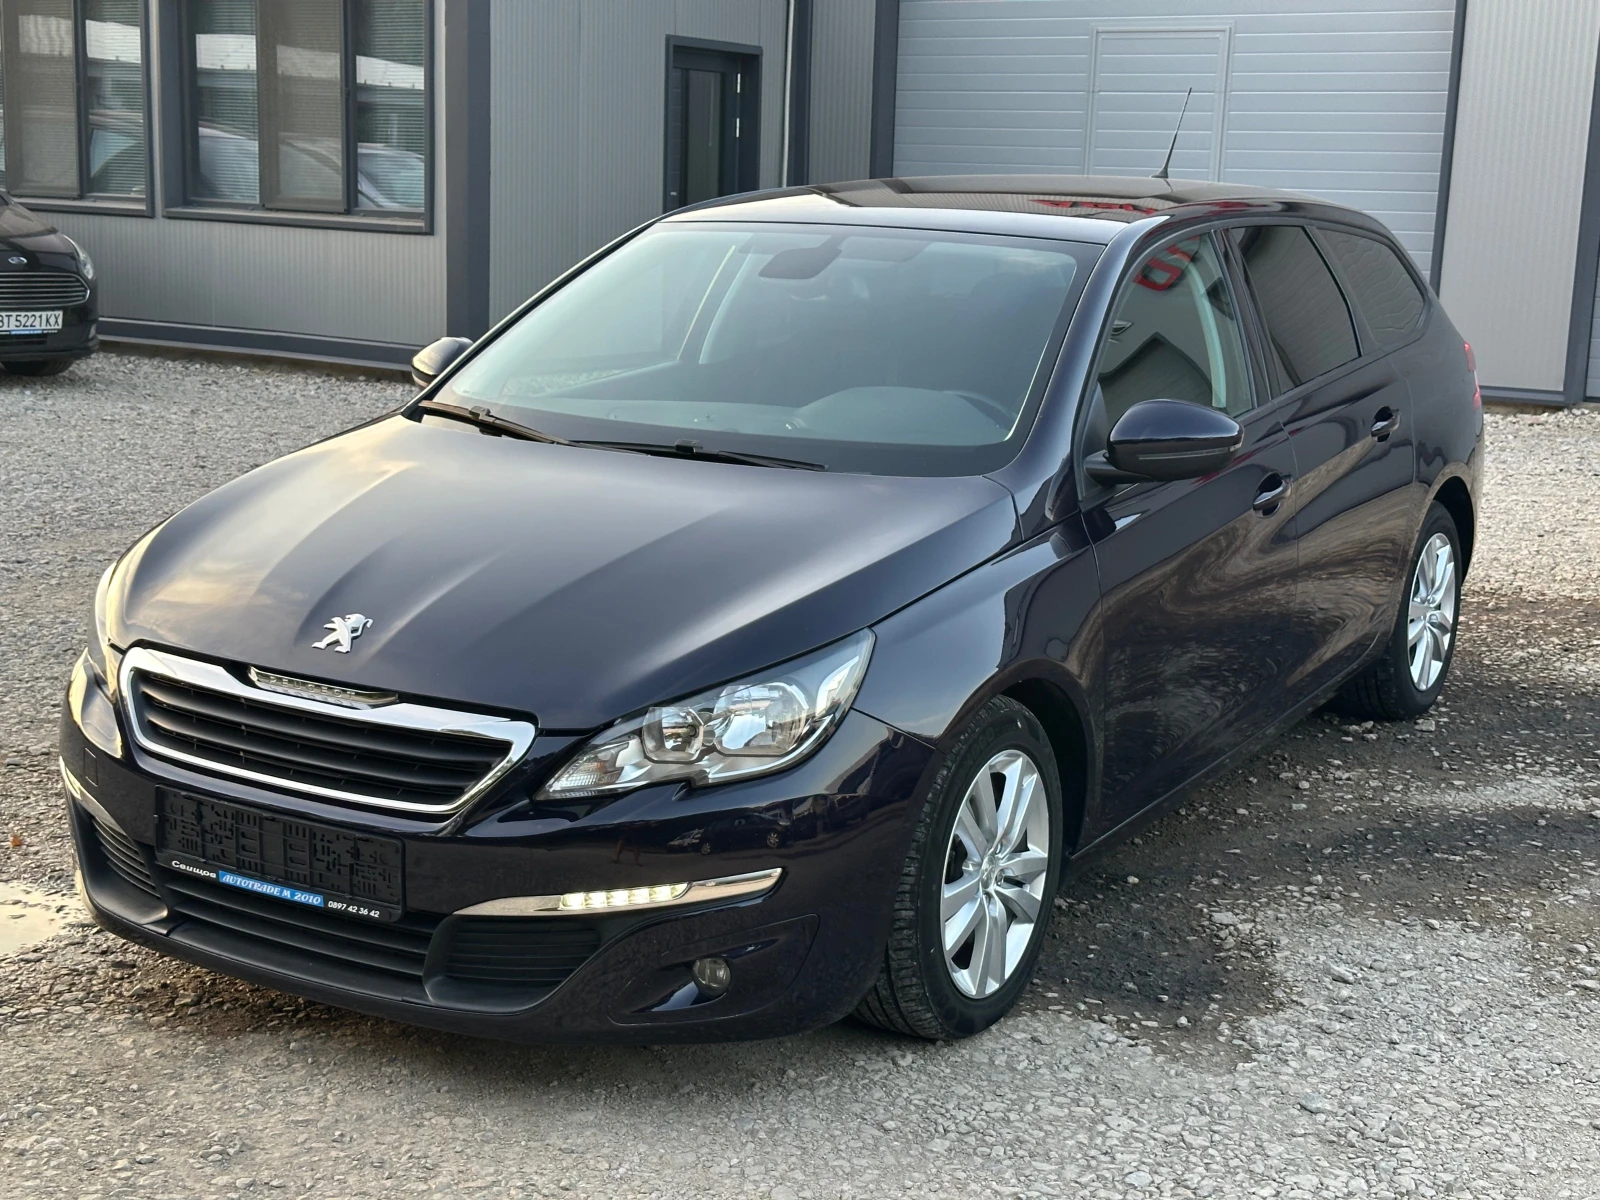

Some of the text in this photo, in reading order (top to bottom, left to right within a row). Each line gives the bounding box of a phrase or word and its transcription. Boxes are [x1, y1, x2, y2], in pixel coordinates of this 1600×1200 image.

[269, 676, 356, 700] PEUGEOT
[222, 874, 321, 905] AUTOTRADE M 2010
[327, 900, 380, 918] 0897 42 36 42
